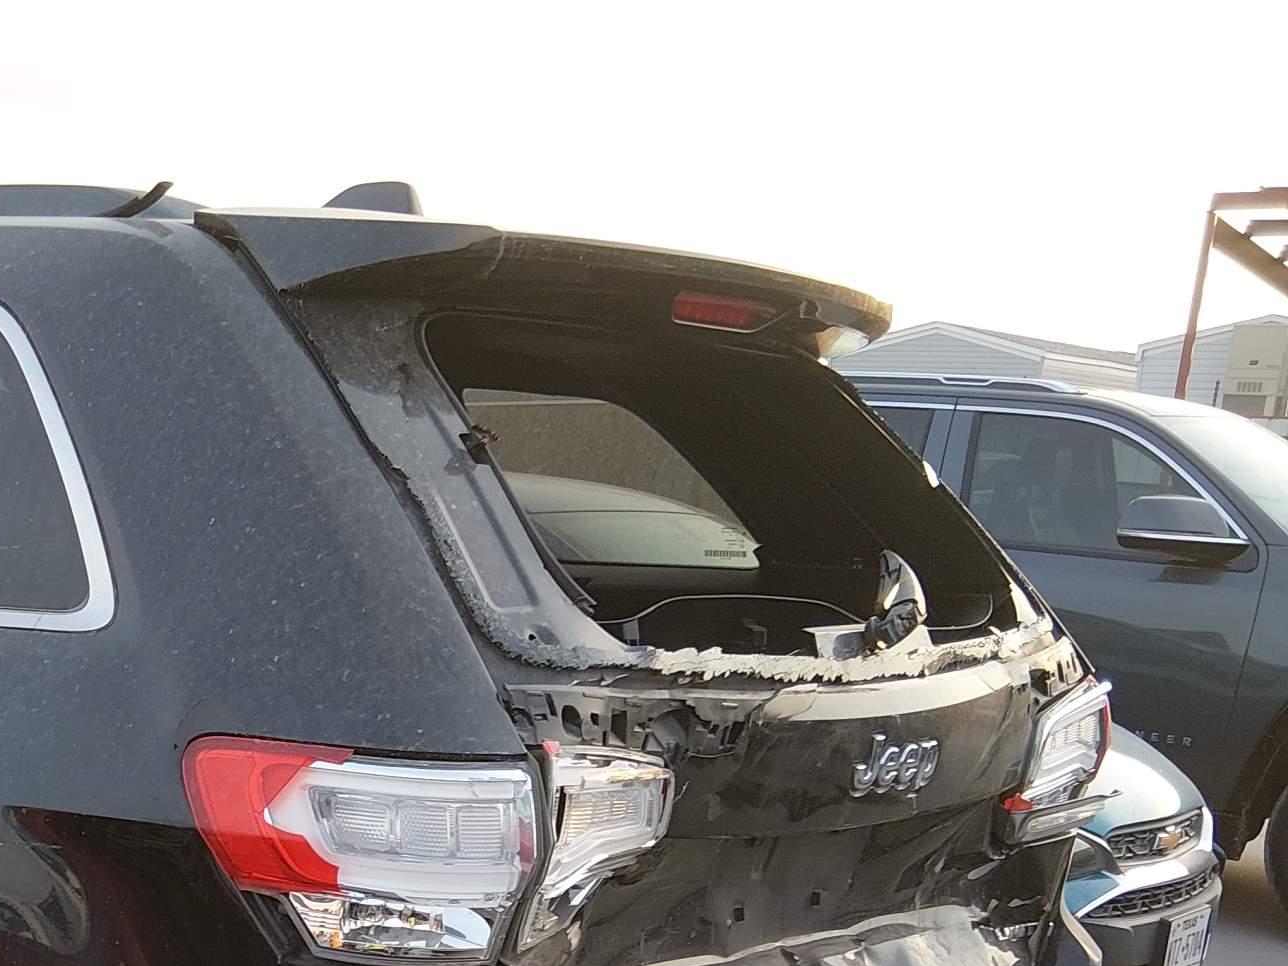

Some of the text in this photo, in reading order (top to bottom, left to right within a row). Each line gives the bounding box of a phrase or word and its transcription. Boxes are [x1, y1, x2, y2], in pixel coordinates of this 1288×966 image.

[1134, 729, 1193, 747] NEER
[851, 732, 940, 794] Jeep
[1183, 915, 1199, 931] TEXAS
